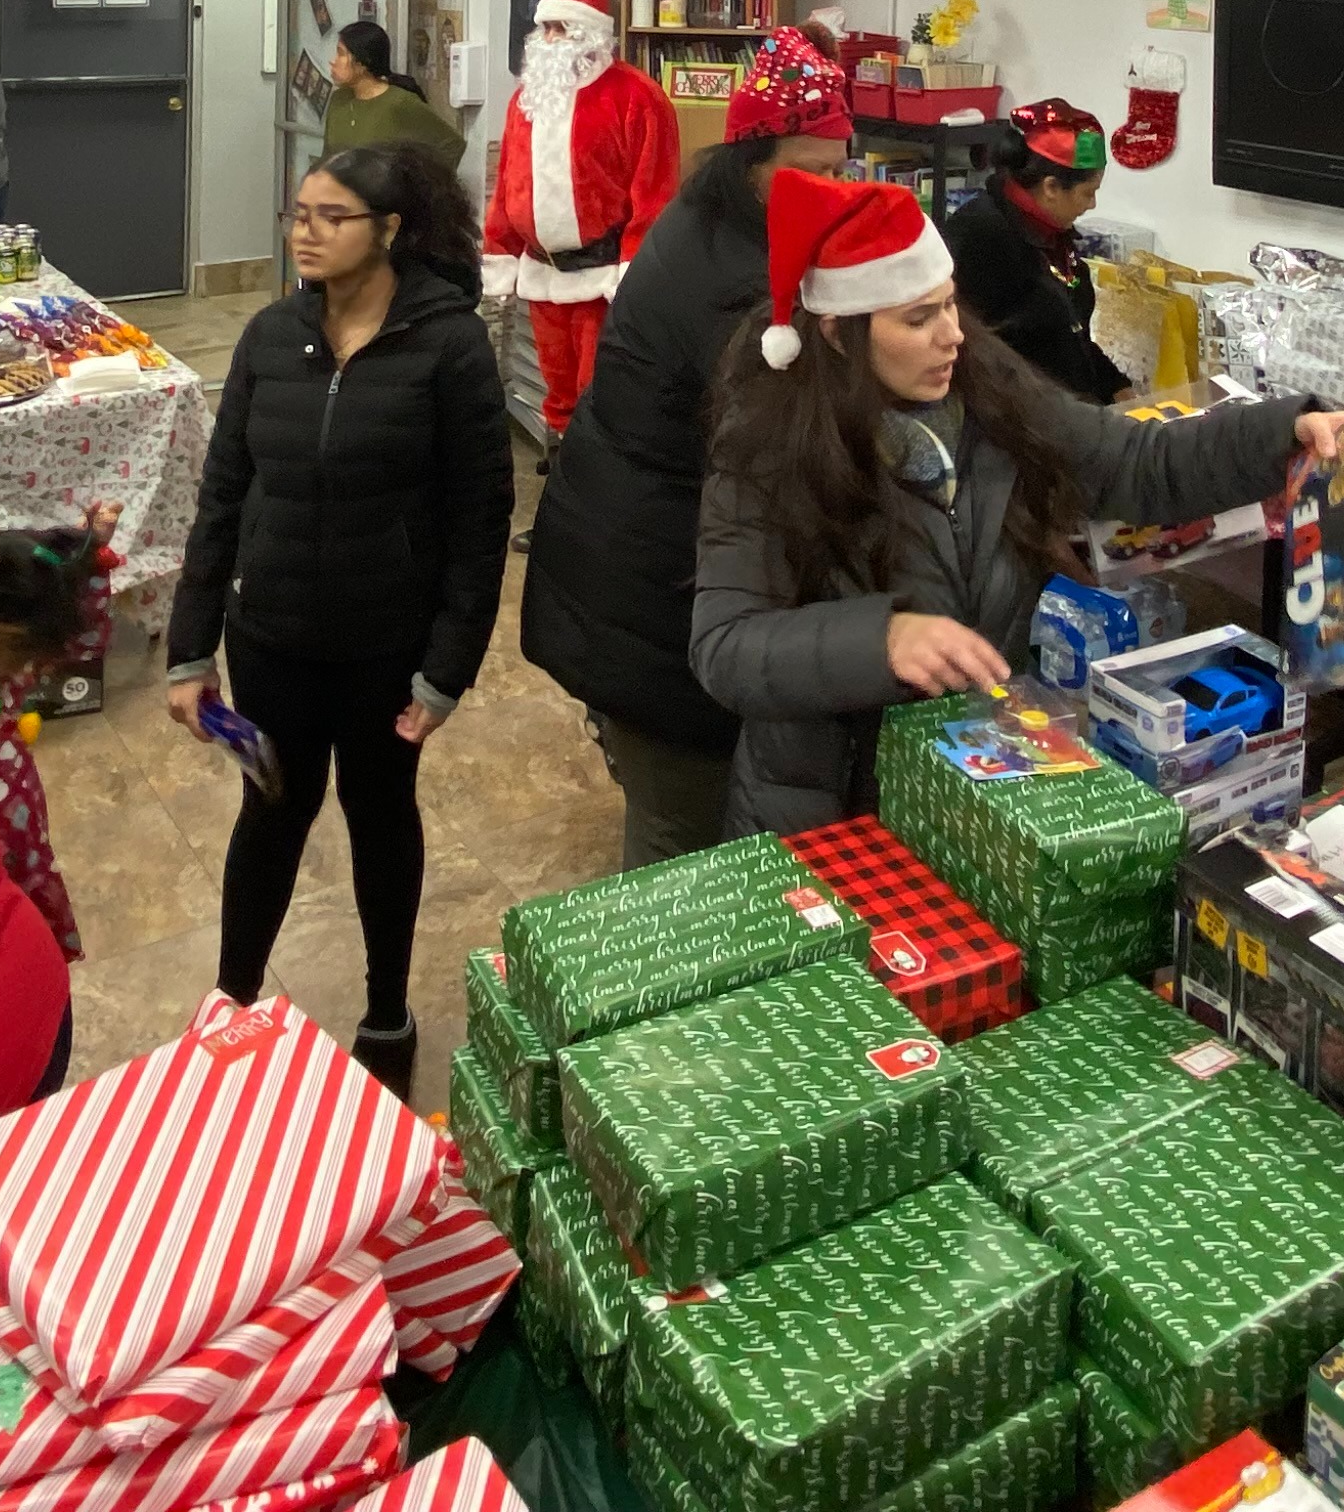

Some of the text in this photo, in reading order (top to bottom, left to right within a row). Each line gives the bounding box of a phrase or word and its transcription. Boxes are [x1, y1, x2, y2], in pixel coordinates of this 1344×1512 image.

[557, 910, 606, 930] merry
[612, 885, 691, 914] christmas
[705, 871, 748, 889] merry
[559, 880, 640, 910] christmas
[653, 866, 698, 887] merry
[703, 844, 777, 871] christmas
[612, 913, 659, 934] merry
[665, 887, 744, 919] christmas
[593, 914, 790, 980] merry christmas merry
[594, 927, 677, 959] christmas
[690, 911, 736, 932] merry
[650, 959, 699, 985] merry
[706, 933, 786, 965] christmas
[809, 986, 849, 1023] merry
[736, 1014, 774, 1054] merry
[772, 1056, 842, 1117] christmas
[753, 995, 819, 1059] christmas
[819, 1065, 862, 1102] merry
[814, 1027, 855, 1061] merry
[739, 1057, 778, 1094] merry
[1073, 1057, 1115, 1087] merry
[657, 1089, 696, 1128] merry
[659, 1044, 696, 1086] merry
[693, 1088, 760, 1152] christmas
[741, 1098, 783, 1136] merry
[1006, 1086, 1048, 1117] merry
[1084, 1090, 1128, 1125] merry
[1014, 1121, 1058, 1155] merry
[1206, 1148, 1258, 1192] merry
[1238, 1146, 1331, 1219] christmas
[1140, 1184, 1192, 1229] merry
[1155, 1135, 1306, 1264] christmas merry
[1173, 1182, 1265, 1260] christmas
[1088, 1170, 1238, 1307] christmas merry
[1104, 1220, 1195, 1301] christmas
